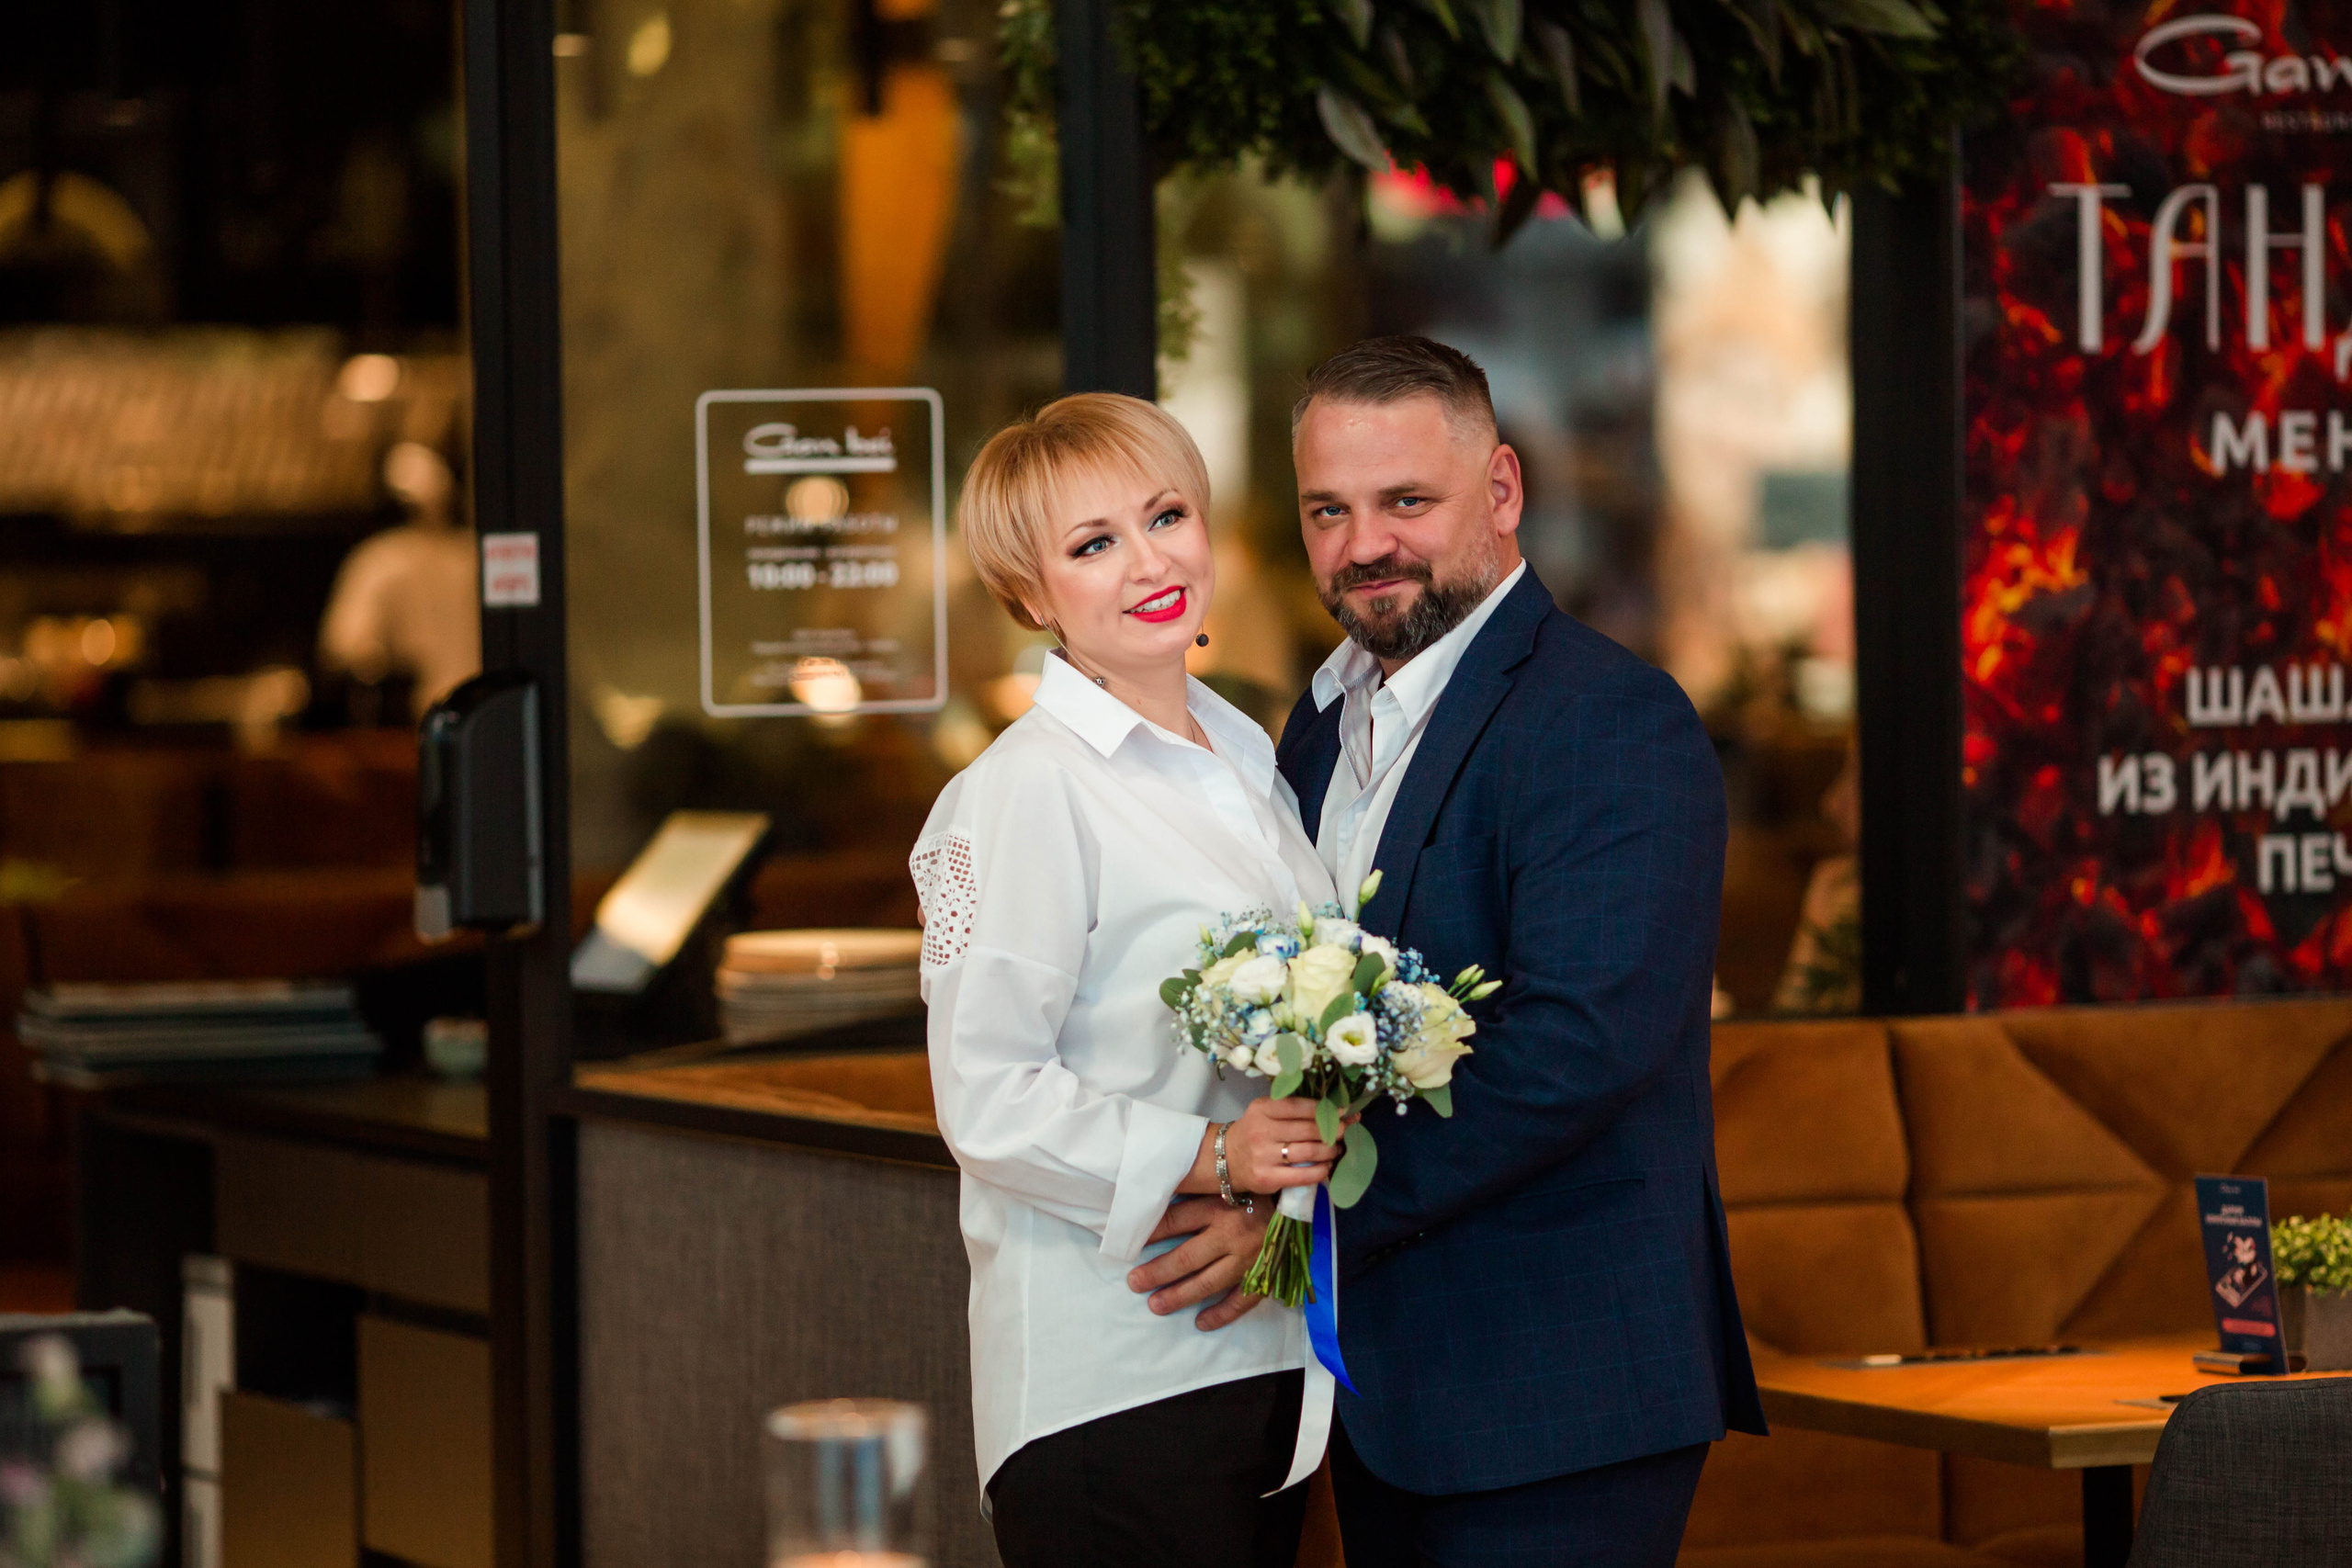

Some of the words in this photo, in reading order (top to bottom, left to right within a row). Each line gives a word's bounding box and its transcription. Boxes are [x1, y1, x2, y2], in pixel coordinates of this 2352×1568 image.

[2048, 183, 2352, 382] ТАН
[2186, 663, 2352, 726] ШАШ
[2098, 752, 2177, 815] ИЗ
[2192, 748, 2352, 822] ИНДИ
